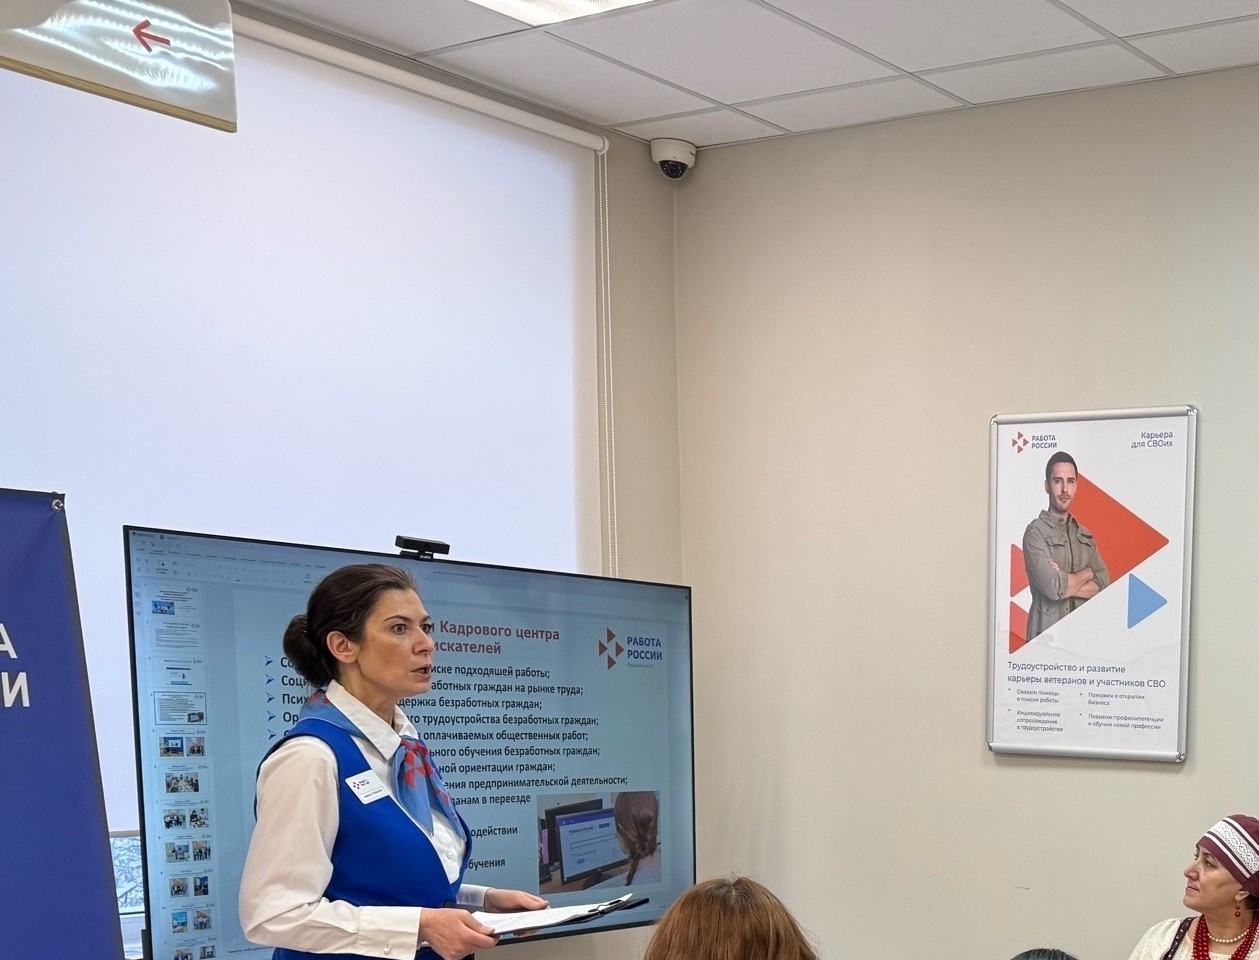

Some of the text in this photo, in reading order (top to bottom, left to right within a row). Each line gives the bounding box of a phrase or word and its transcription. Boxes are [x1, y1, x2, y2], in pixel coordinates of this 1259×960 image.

[1031, 434, 1056, 442] РАБОТА
[1141, 431, 1173, 440] Карьера
[1131, 439, 1173, 449] для СВОих
[440, 620, 511, 637] Кадрового
[516, 628, 559, 641] центра
[433, 641, 501, 655] искателей
[627, 636, 662, 648] РАБОТА
[627, 649, 663, 661] РОССИИ
[431, 664, 452, 675] иске
[515, 666, 550, 679] работы;
[1008, 661, 1077, 672] Трудоустройство
[1086, 665, 1126, 674] развитие
[1007, 675, 1042, 684] карьеры
[1044, 677, 1087, 686] ветеранов
[1096, 679, 1145, 688] участников
[1147, 679, 1166, 688] СВО
[431, 680, 584, 697] аботных граждан на рынке труда;
[399, 697, 542, 711] держка безработных граждан;
[422, 713, 500, 726] трудоустройства
[503, 714, 559, 726] безработных
[561, 716, 599, 727] граждан;
[423, 732, 494, 741] оплачиваемых
[496, 730, 560, 742] общественных
[562, 731, 588, 741] работ;
[459, 746, 502, 758] обучения
[504, 746, 560, 757] безработных
[562, 748, 600, 757] граждан;
[459, 763, 513, 774] ориентации
[516, 762, 556, 772] граждан;
[468, 776, 569, 790] предпринимательской
[571, 775, 628, 787] деятельности;
[489, 794, 531, 805] переезде
[471, 826, 518, 837] одействии
[468, 858, 506, 870] бучения
